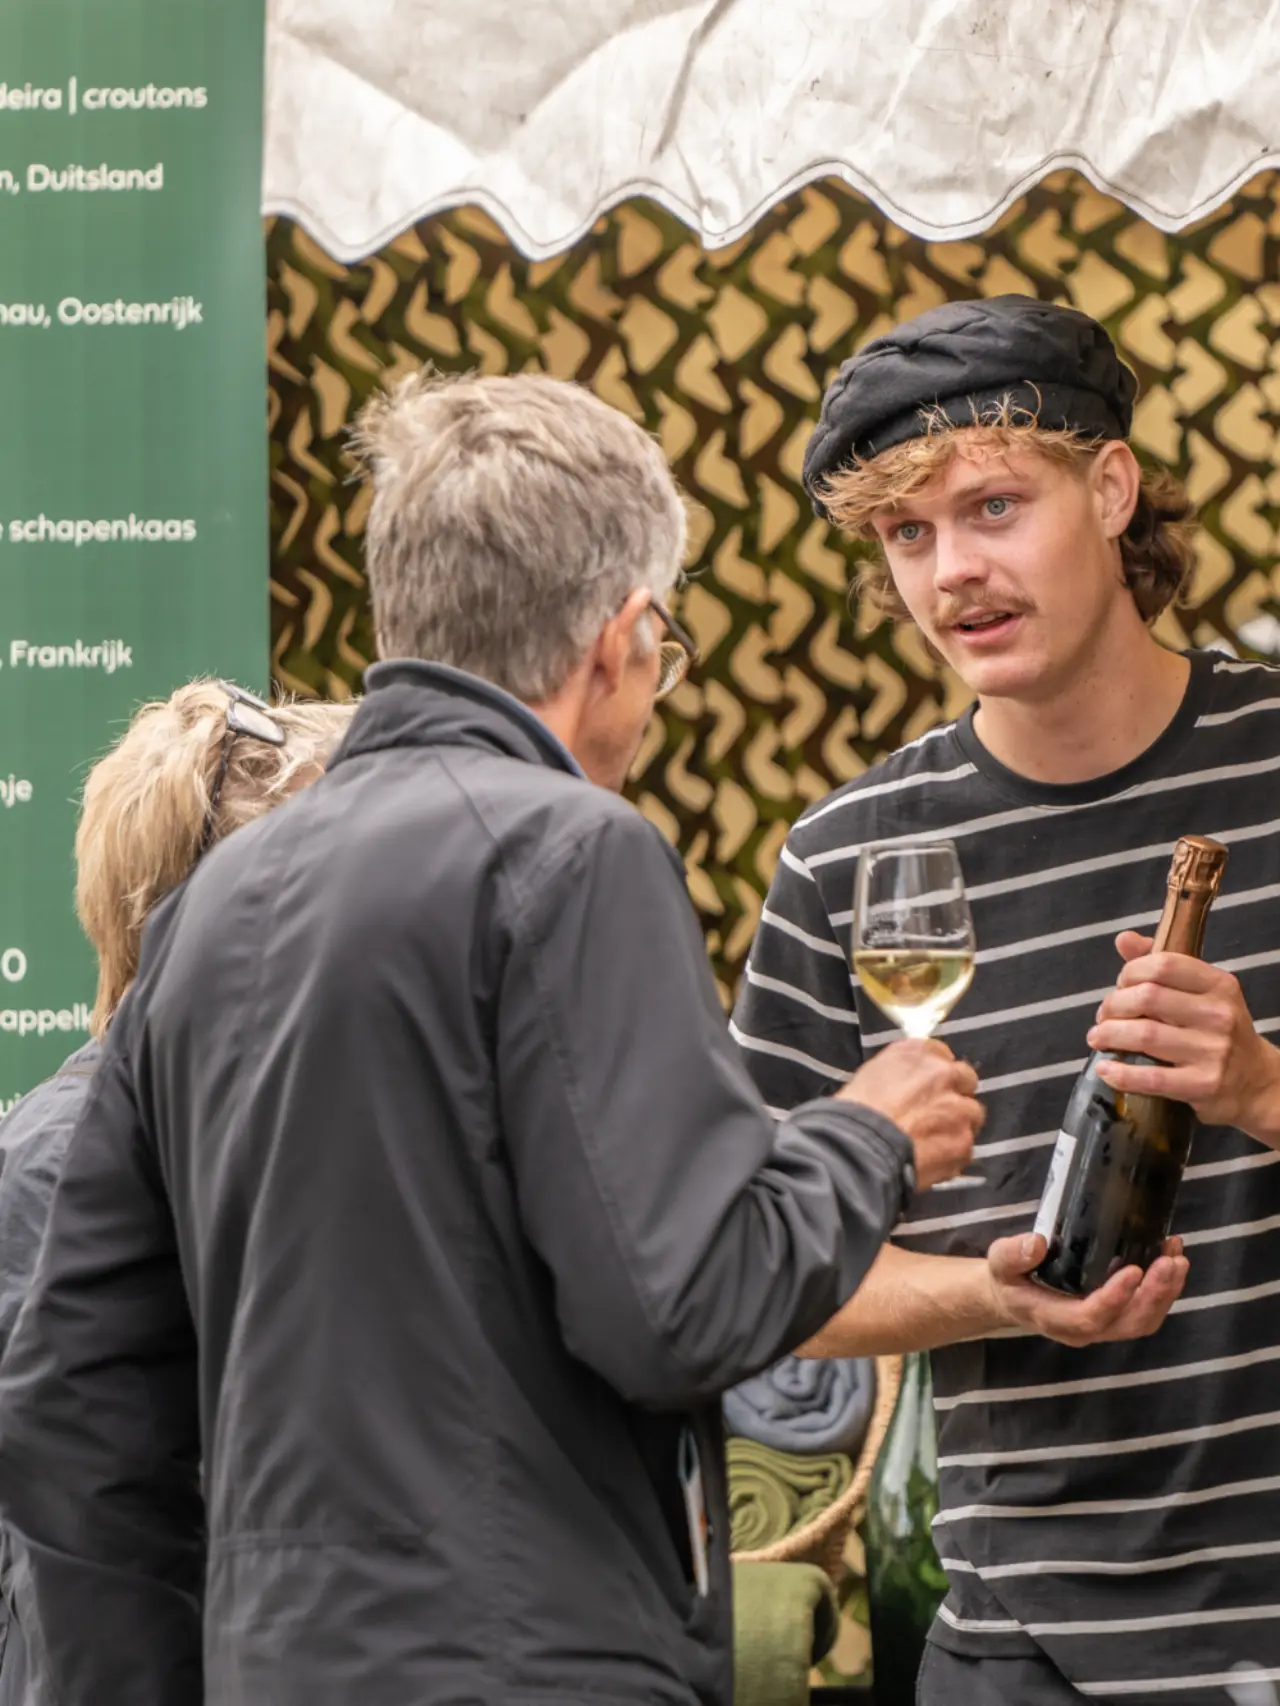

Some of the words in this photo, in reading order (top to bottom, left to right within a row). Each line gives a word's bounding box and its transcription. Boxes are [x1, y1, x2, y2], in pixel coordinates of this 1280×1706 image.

[82, 82, 208, 110] croutons
[27, 162, 164, 191] Duitsland
[57, 296, 204, 331] Oostenrijk
[9, 512, 197, 547] schapenkaas
[10, 639, 133, 674] Frankrijk
